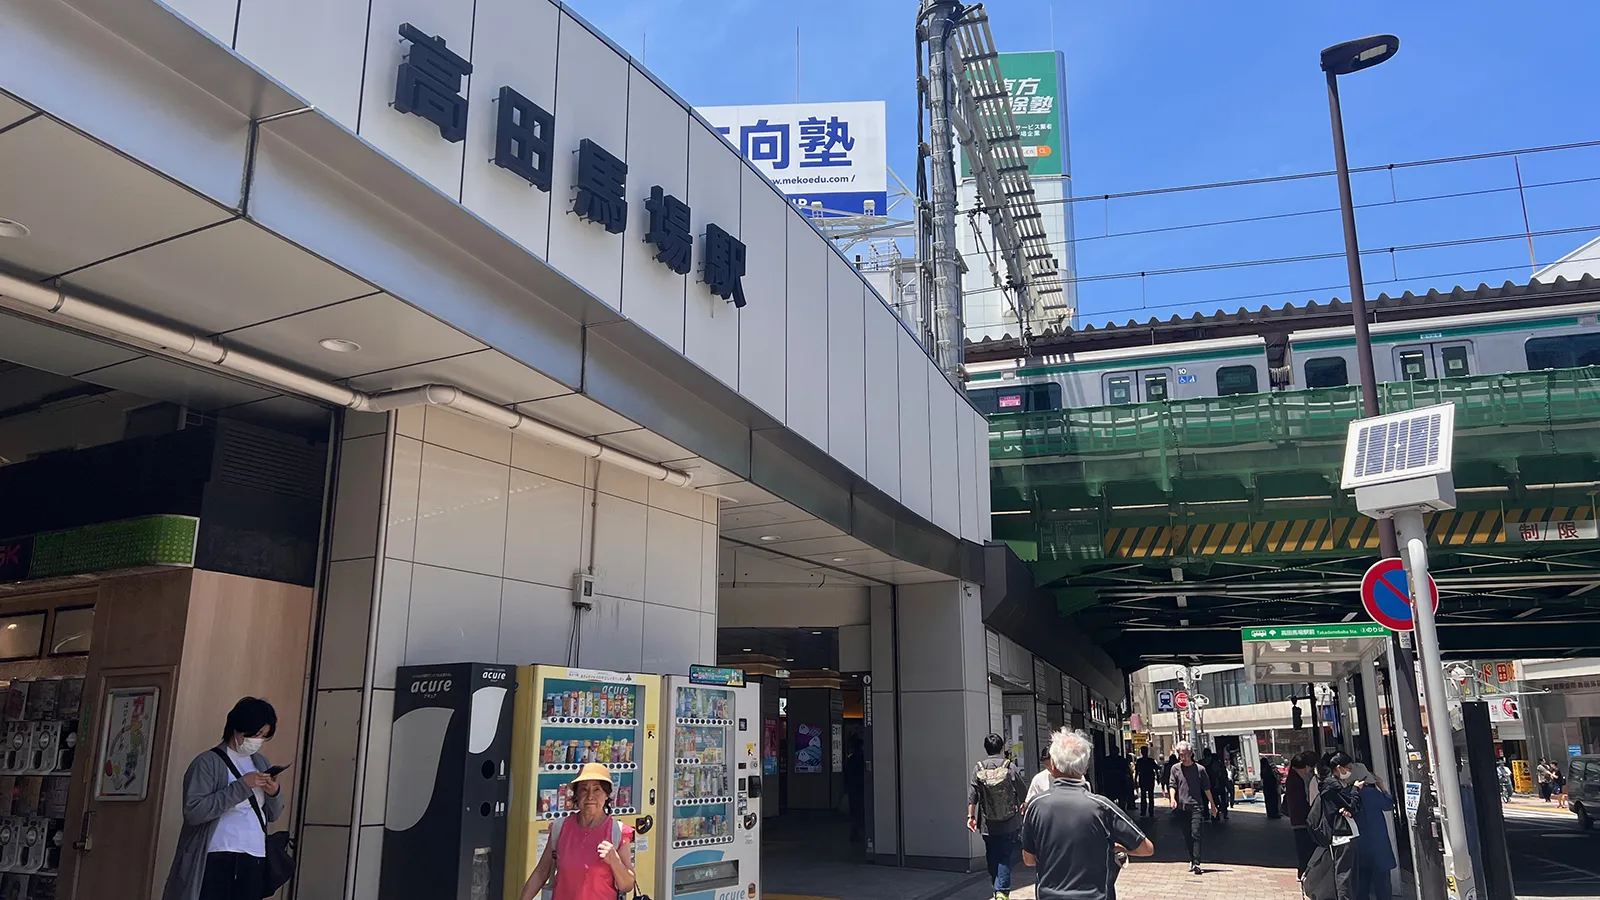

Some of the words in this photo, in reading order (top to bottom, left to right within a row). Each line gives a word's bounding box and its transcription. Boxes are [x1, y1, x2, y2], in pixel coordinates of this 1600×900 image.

[715, 116, 855, 169] 向塾
[394, 22, 746, 308] 高田馬場駅
[1518, 521, 1579, 540] 制限
[482, 671, 507, 680] acure
[410, 679, 453, 694] acure
[601, 685, 629, 695] acure
